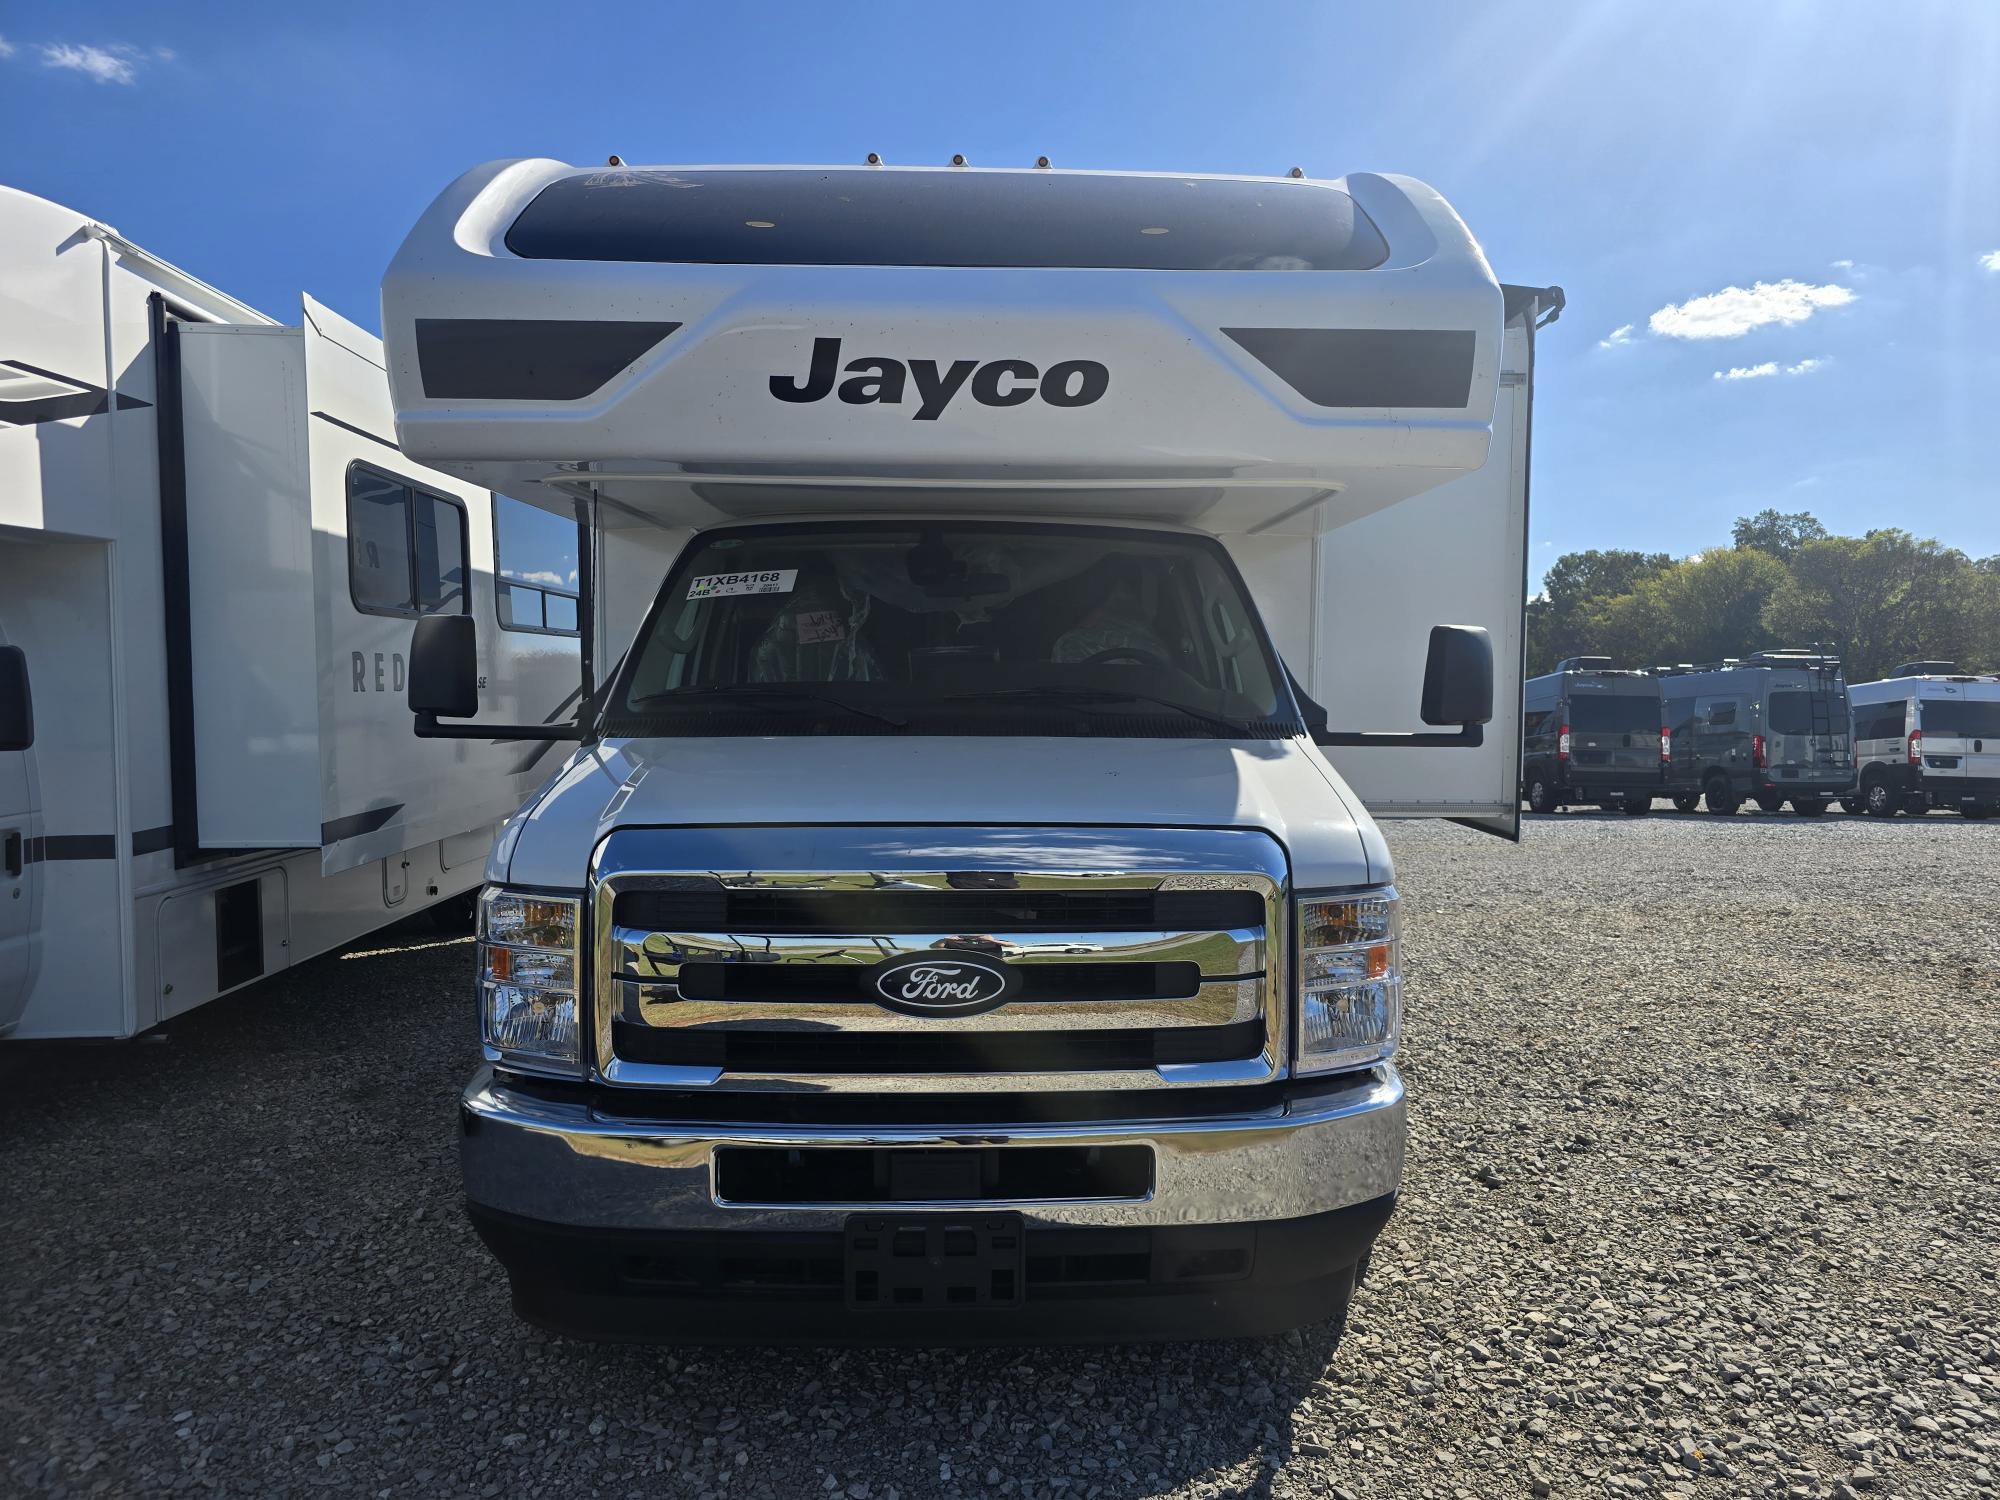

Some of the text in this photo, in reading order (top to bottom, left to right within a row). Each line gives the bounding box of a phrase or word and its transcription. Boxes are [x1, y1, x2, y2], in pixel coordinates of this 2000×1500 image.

[769, 337, 1110, 420] Jayco
[694, 572, 780, 588] T1XB4168
[688, 589, 711, 598] 24B
[901, 967, 979, 999] Ford
